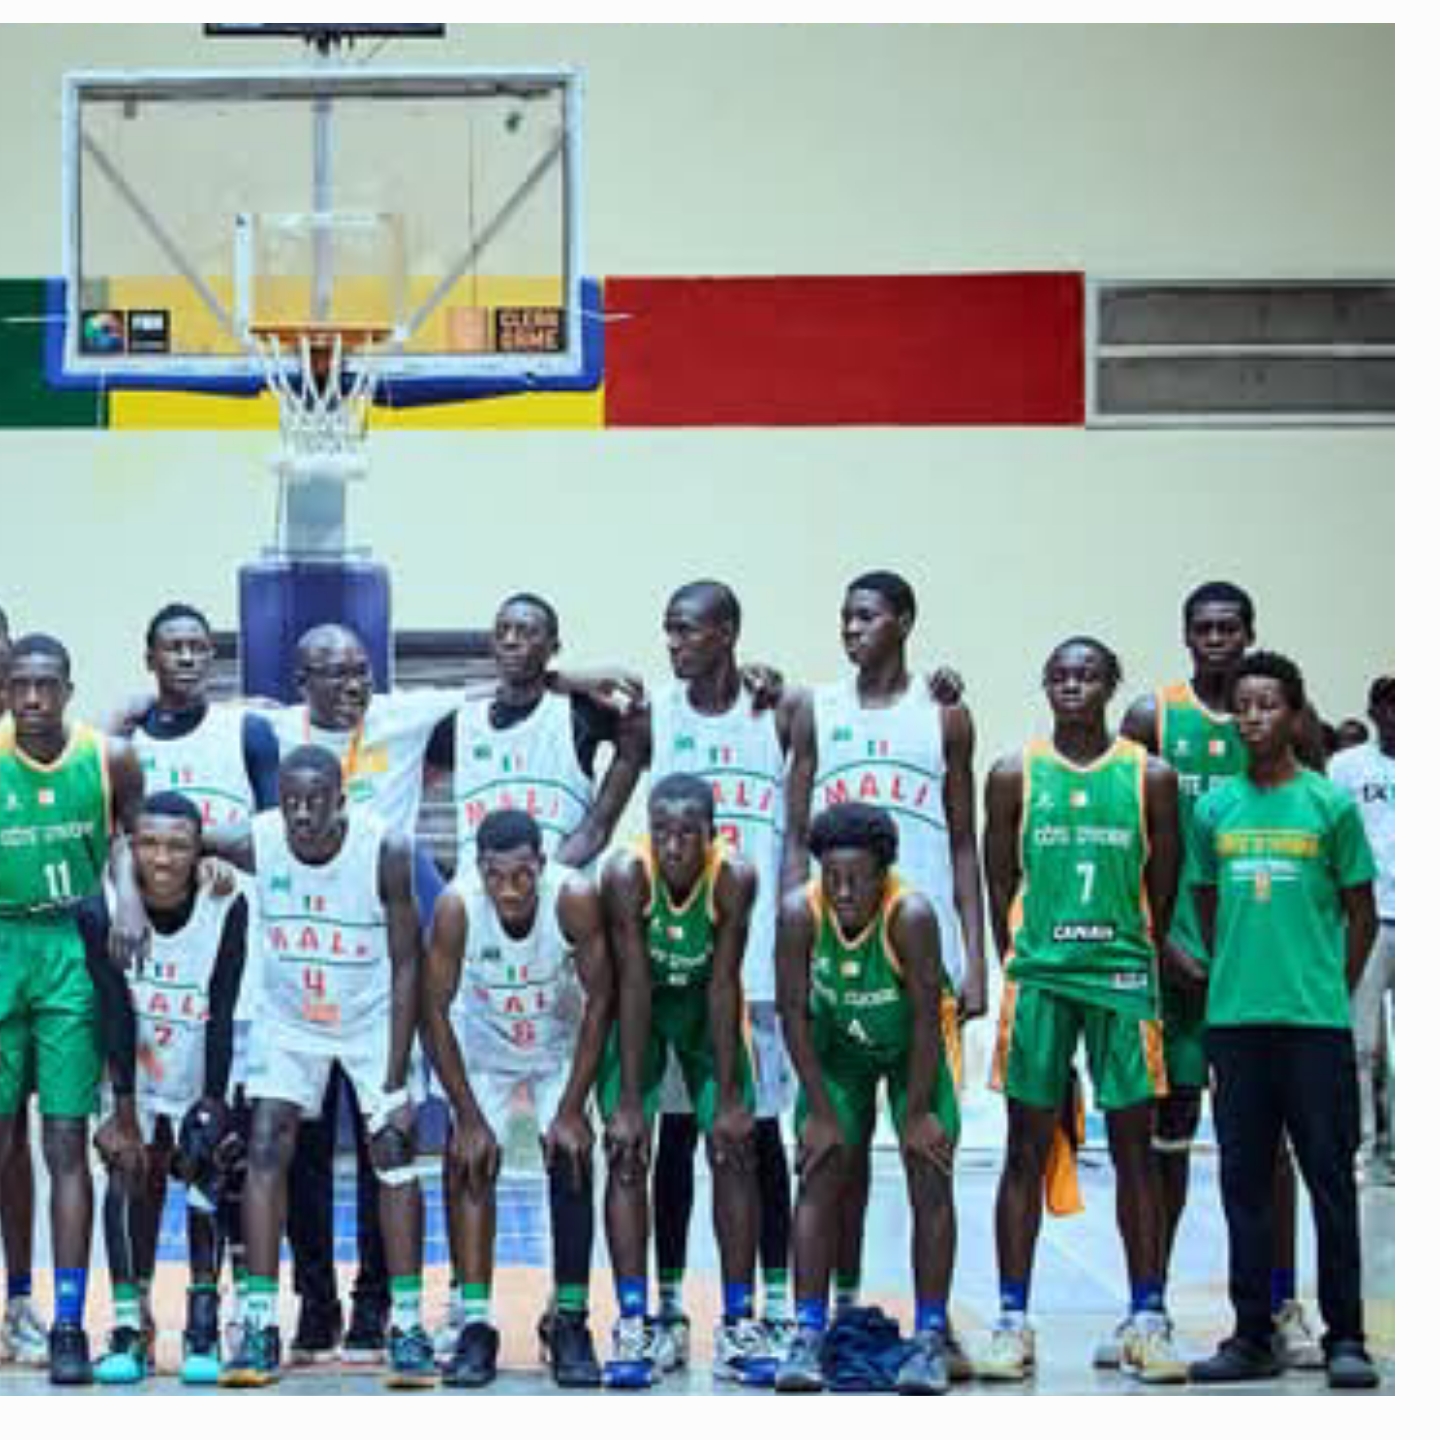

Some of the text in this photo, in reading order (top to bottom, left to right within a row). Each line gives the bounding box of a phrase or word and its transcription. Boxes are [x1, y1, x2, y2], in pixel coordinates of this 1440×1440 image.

[43, 863, 72, 899] 11
[1076, 861, 1095, 903] 7
[302, 967, 326, 999] 4
